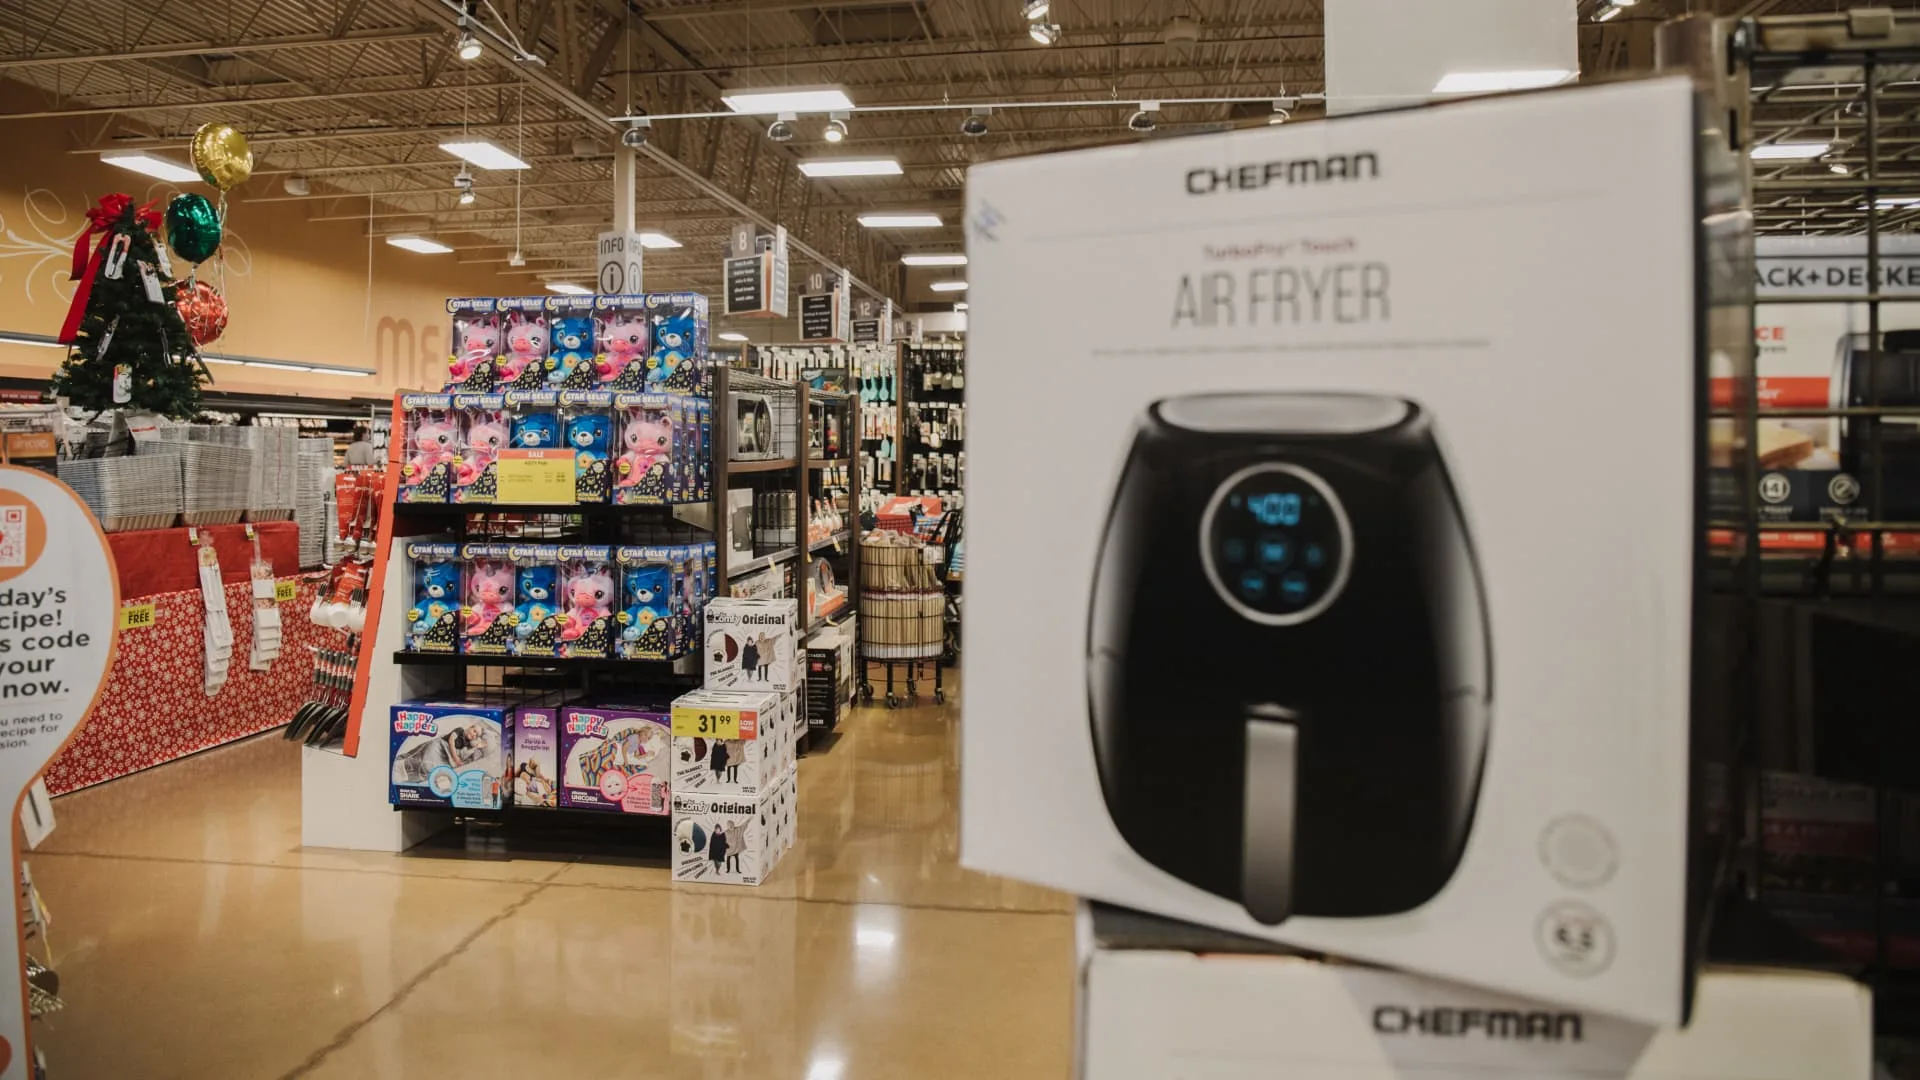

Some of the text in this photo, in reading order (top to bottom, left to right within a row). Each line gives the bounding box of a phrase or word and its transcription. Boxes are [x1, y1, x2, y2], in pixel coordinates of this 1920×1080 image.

[1185, 151, 1380, 195] CHEFMAN
[600, 237, 624, 255] INFO
[739, 232, 747, 251] 8
[809, 273, 822, 290] 10
[1753, 267, 1920, 287] ACK+DEKE
[1171, 262, 1392, 328] AIR FRYER
[376, 316, 440, 386] ME
[0, 587, 67, 609] day's
[0, 609, 62, 632] cipe!
[128, 612, 150, 625] FREE
[742, 613, 785, 625] Original
[22, 630, 90, 651] code
[3, 680, 69, 698] now.
[13, 713, 45, 725] need
[49, 712, 63, 721] to
[397, 711, 433, 723] Happy
[569, 712, 605, 725] Happy
[0, 723, 58, 738] ecipe for
[394, 720, 438, 734] Nappers
[567, 722, 609, 737] Nappers
[0, 740, 29, 749] sion.
[711, 802, 756, 815] Original
[1372, 1005, 1583, 1042] CHEFMAN
